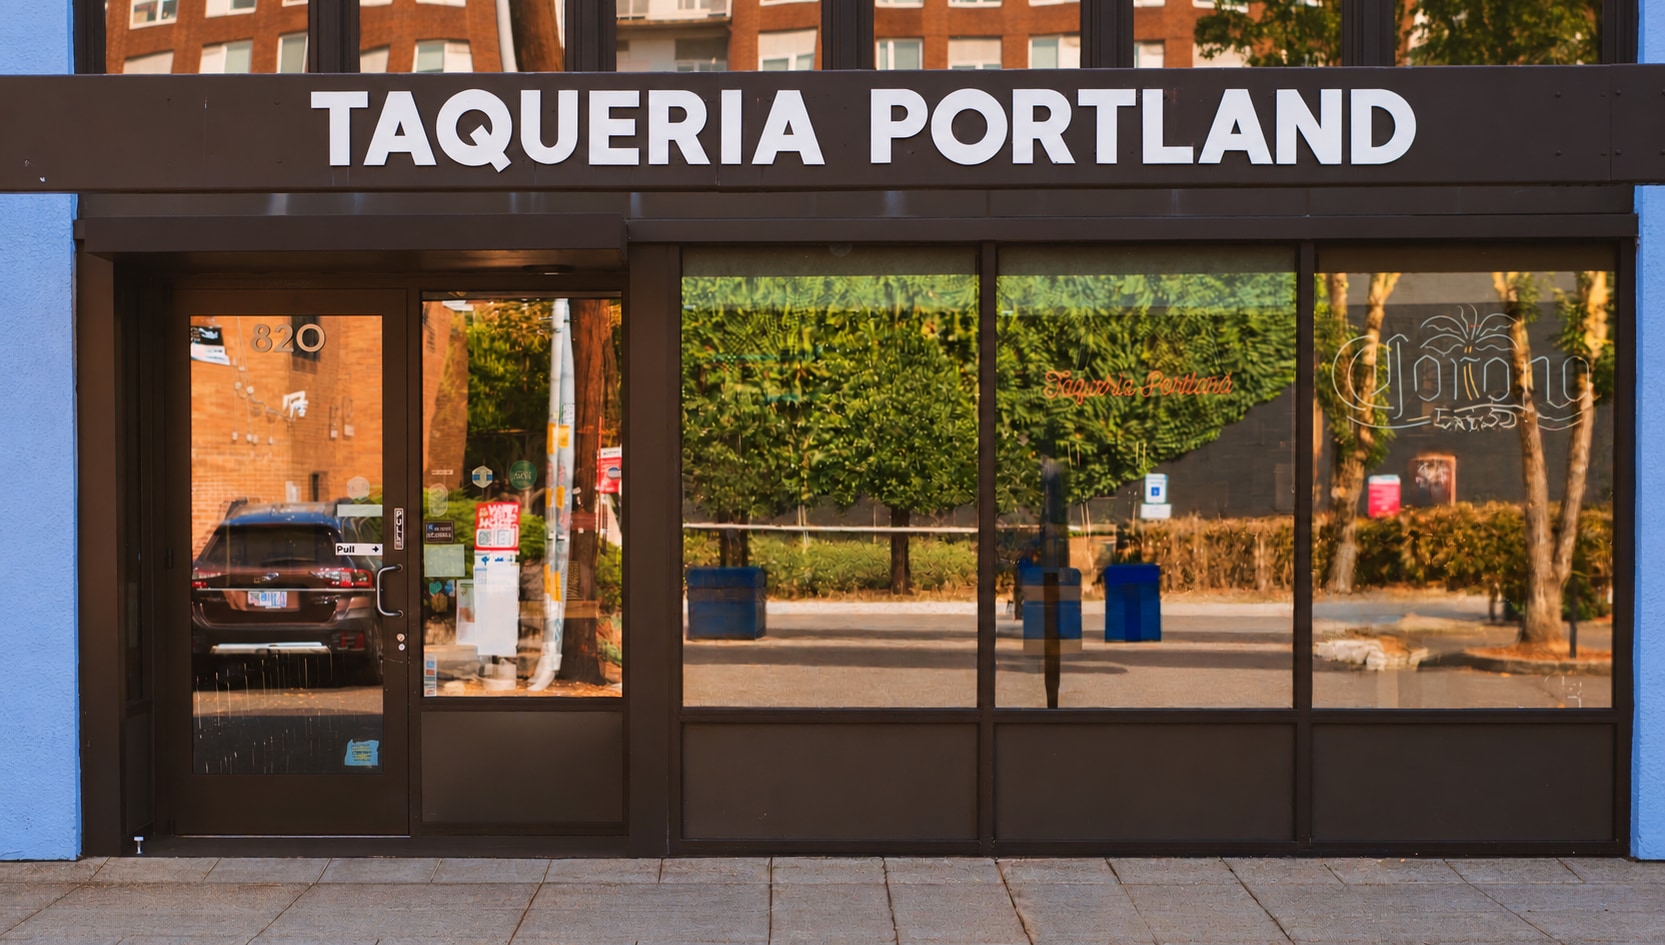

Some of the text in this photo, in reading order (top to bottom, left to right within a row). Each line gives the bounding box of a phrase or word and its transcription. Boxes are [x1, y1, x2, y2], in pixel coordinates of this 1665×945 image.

[310, 88, 1417, 173] TAQUERIA PORTLAND
[250, 323, 326, 353] 820
[1043, 369, 1234, 405] Taqueria Portland
[336, 545, 355, 553] Pull
